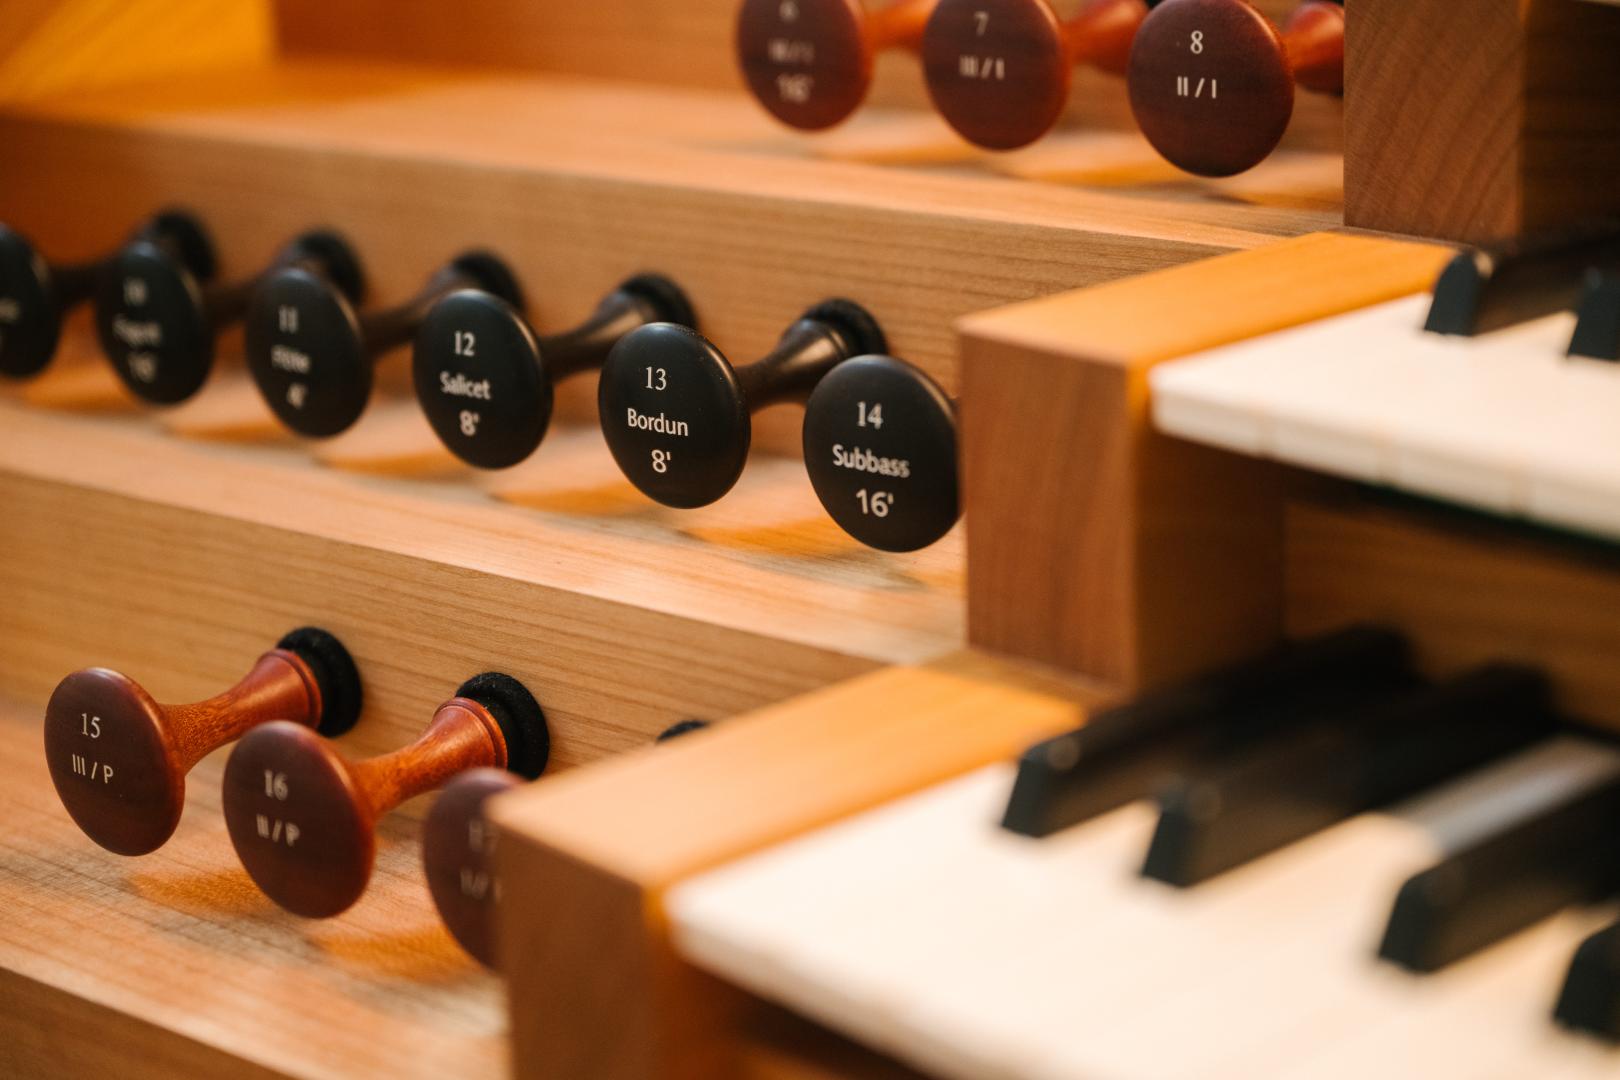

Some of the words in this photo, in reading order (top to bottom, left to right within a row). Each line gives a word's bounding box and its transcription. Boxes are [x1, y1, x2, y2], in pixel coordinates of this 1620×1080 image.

[974, 10, 989, 36] 7
[1190, 30, 1203, 54] 8
[454, 330, 476, 357] 12
[440, 371, 491, 401] Salicet
[645, 366, 667, 391] 13
[459, 410, 480, 437] 8'
[627, 407, 689, 437] Bordun
[857, 400, 884, 430] 14
[651, 449, 671, 473] 8'
[832, 443, 911, 479] Subbass
[856, 488, 895, 518] 16'
[81, 712, 101, 739] 15
[264, 769, 288, 801] 16
